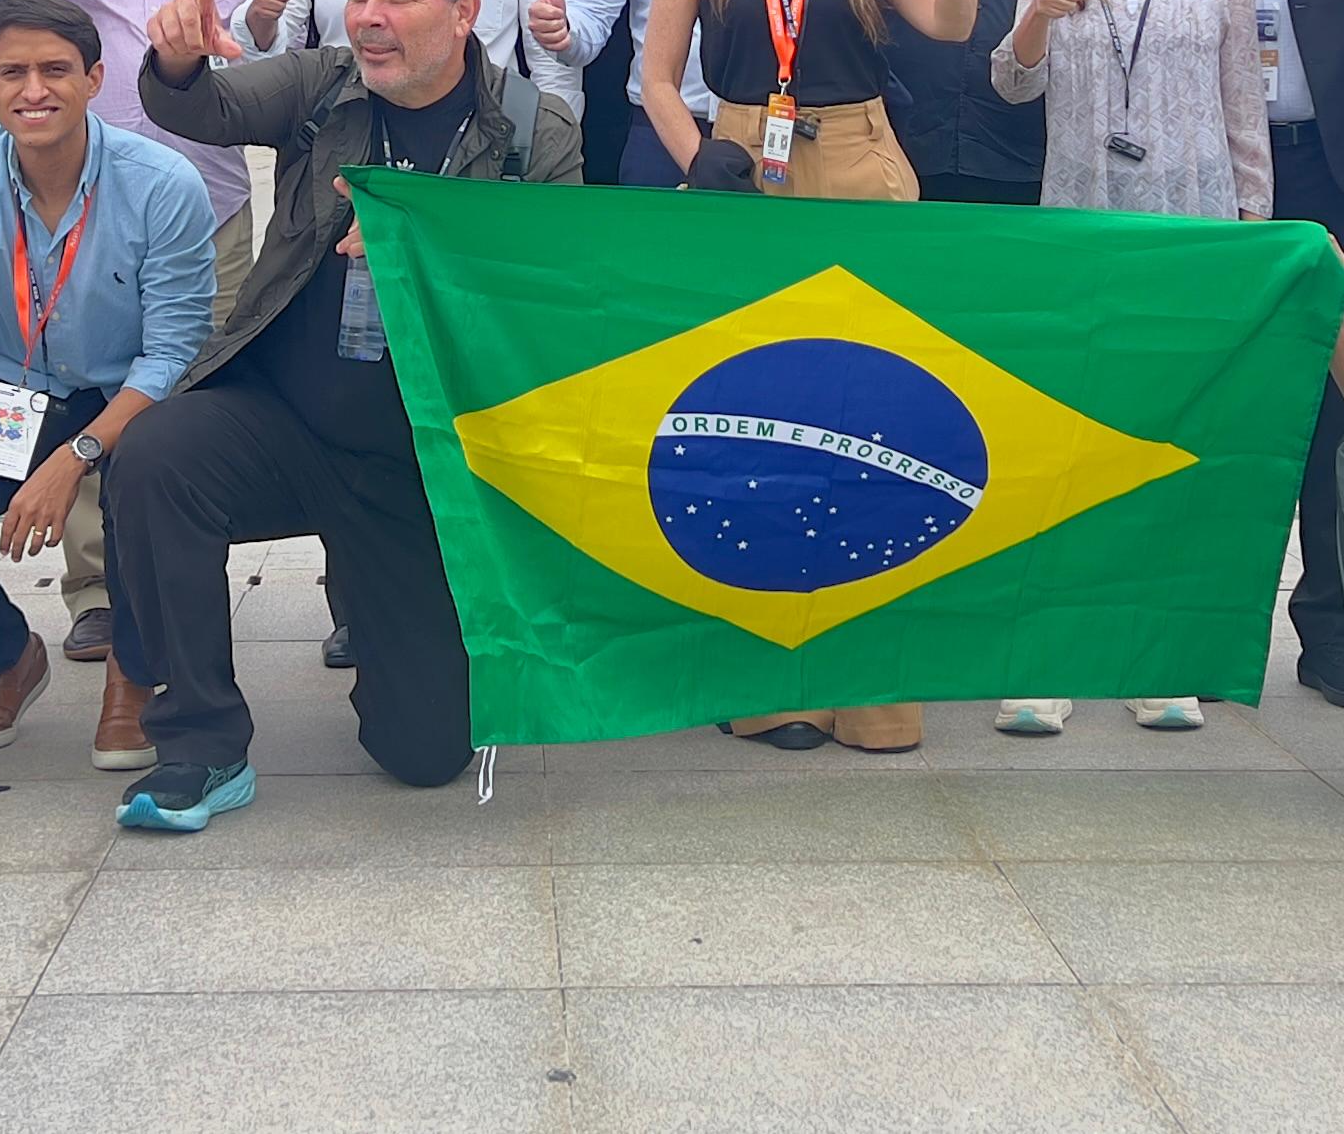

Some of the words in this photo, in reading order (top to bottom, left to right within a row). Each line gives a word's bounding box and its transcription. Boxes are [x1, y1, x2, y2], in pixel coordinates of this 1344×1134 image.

[671, 416, 776, 438] ORDEM
[790, 428, 805, 442] E
[819, 432, 976, 501] PROGRESSO
